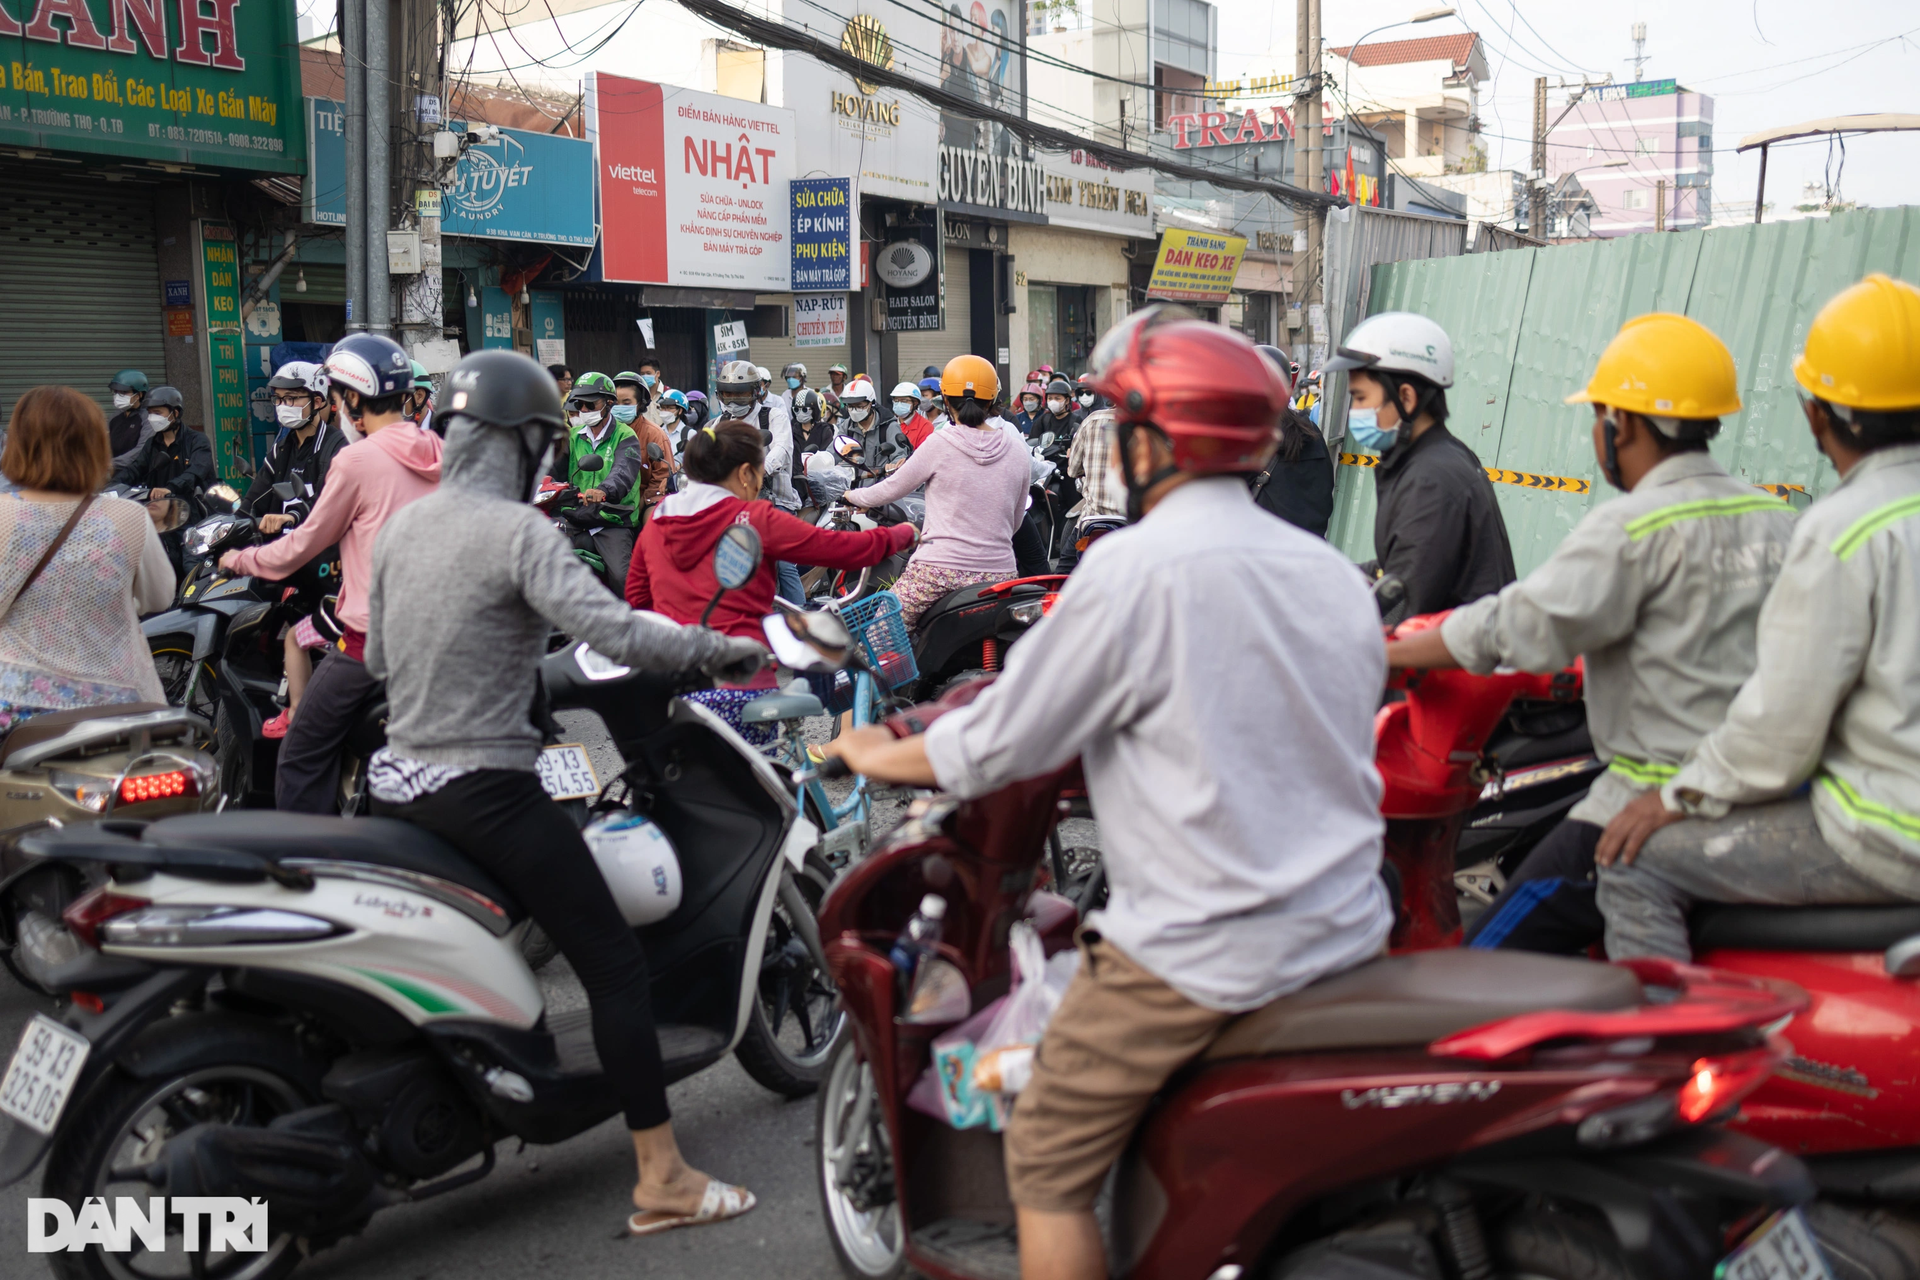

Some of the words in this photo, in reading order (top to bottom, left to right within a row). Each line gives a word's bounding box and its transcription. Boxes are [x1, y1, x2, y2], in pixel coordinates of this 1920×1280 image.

[11, 61, 49, 98] Bán,
[51, 67, 88, 99] Trao
[92, 69, 123, 107] Đổi,
[126, 78, 156, 108] Các
[160, 83, 192, 117] Loại
[196, 87, 215, 116] Xe
[218, 87, 245, 119] Gắn
[248, 95, 277, 126] Máy
[831, 91, 901, 126] HOYANG
[73, 114, 93, 133] THỌ
[316, 108, 345, 137] TIỆ
[677, 102, 701, 121] ĐIỂM
[702, 109, 721, 124] BÁN
[722, 113, 747, 129] HÀNG
[747, 119, 781, 135] VIETTEL
[684, 132, 776, 190] NHẬT
[608, 163, 658, 184] viettel
[632, 186, 658, 197] telecom
[796, 187, 816, 208] SỬA
[817, 186, 845, 207] CHỮA
[1046, 174, 1073, 205] KIM
[1077, 176, 1119, 212] THIÊN
[1124, 188, 1149, 217] NGA
[453, 203, 504, 220] LAUNDRY
[737, 199, 764, 211] UNLOCK
[697, 208, 717, 221] NÂNG
[717, 209, 731, 222] CẤP
[797, 214, 812, 233] ÉP
[814, 212, 845, 233] KÍNH
[706, 227, 723, 239] ĐỊNH
[760, 231, 783, 244] NGHIỆP
[944, 221, 970, 239] ALON
[703, 241, 718, 253] BÁN
[719, 242, 734, 254] MÁY
[749, 245, 763, 257] GÓP
[796, 243, 817, 262] PHỤ
[820, 238, 846, 261] KIỆN
[1209, 239, 1227, 250] SANG
[206, 244, 234, 267] NHẬN
[1164, 246, 1194, 267] DÁN
[1194, 252, 1220, 270] KEO
[1219, 255, 1236, 271] XE
[211, 268, 232, 287] DÁN
[796, 268, 808, 283] BÁN
[809, 267, 821, 283] MÁY
[822, 265, 833, 282] TRẢ
[834, 264, 846, 282] GÓP
[167, 287, 188, 296] XANH
[214, 296, 234, 312] KEO
[795, 293, 845, 315] NẠP-RÚT
[889, 296, 909, 308] HAIR
[910, 295, 935, 307] SALON
[919, 311, 938, 329] BÌNH
[720, 324, 735, 338] SIM
[219, 341, 235, 360] TRÍ
[732, 338, 747, 349] 85K
[219, 368, 239, 388] PHỤ
[217, 389, 243, 408] TÙNG
[1711, 541, 1782, 573] CENTR
